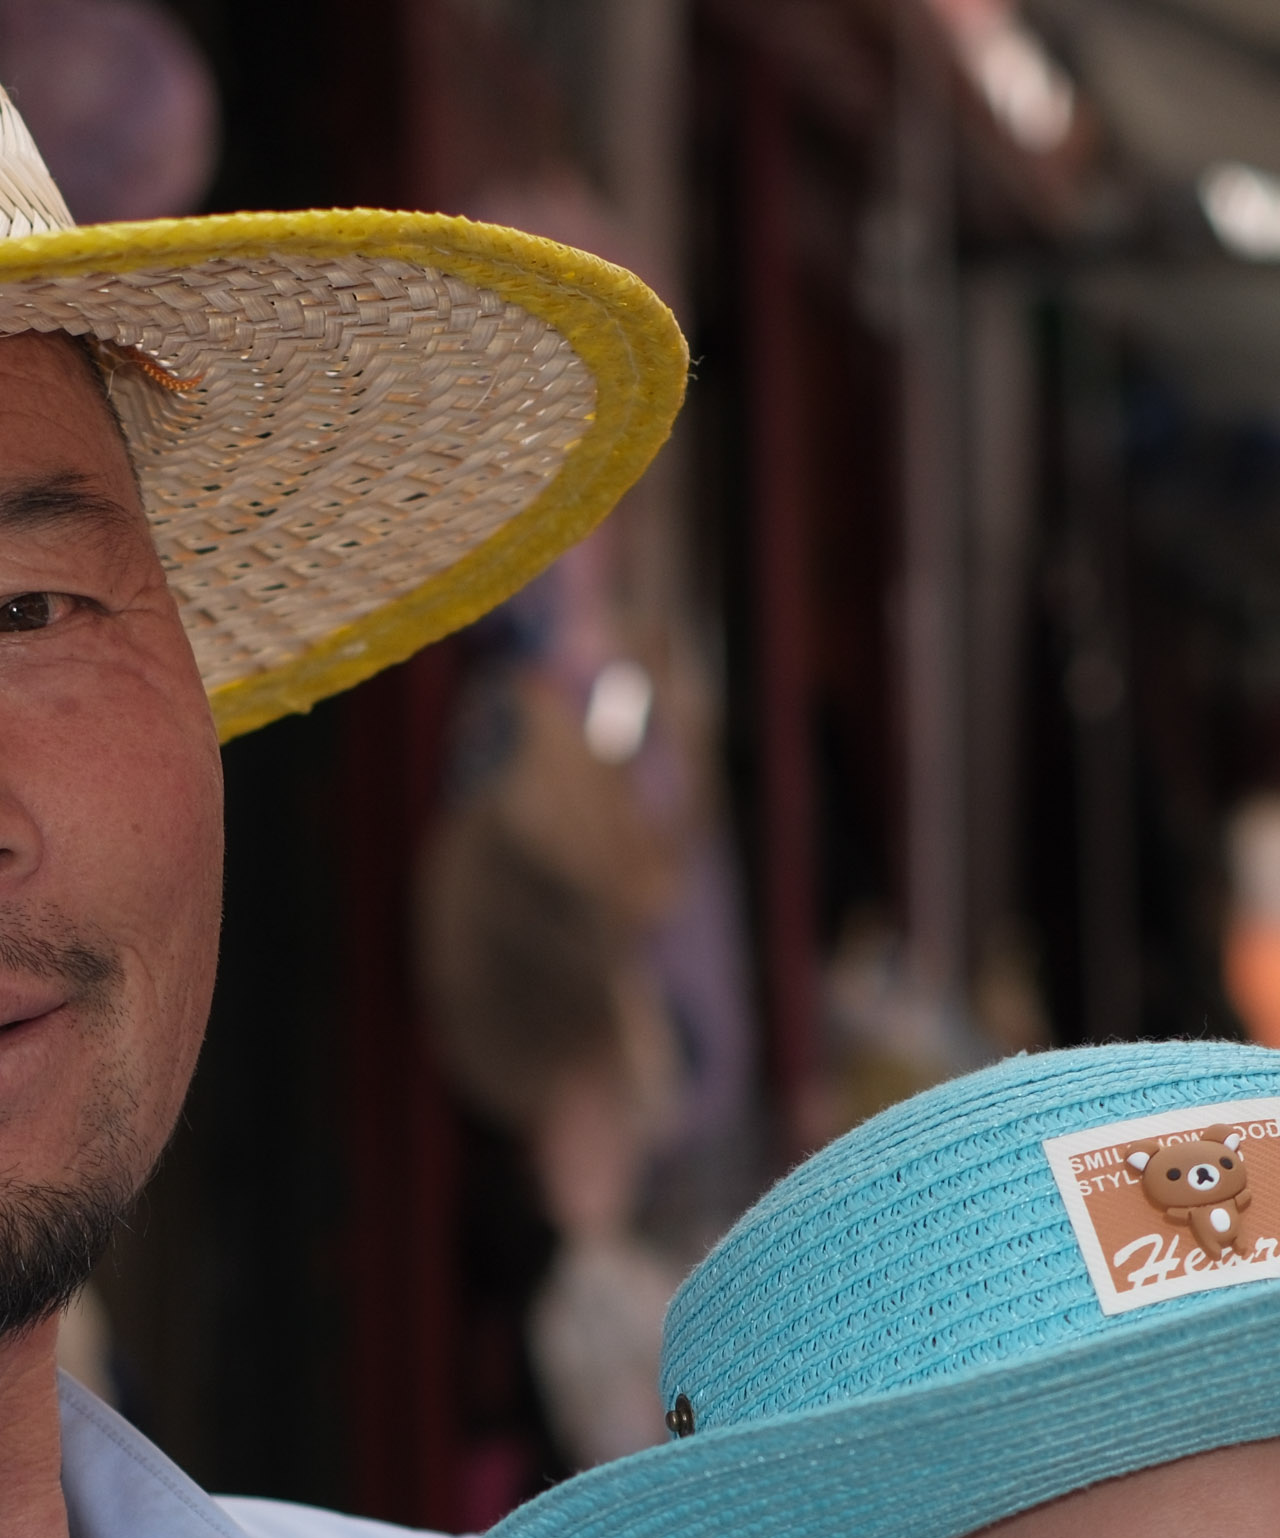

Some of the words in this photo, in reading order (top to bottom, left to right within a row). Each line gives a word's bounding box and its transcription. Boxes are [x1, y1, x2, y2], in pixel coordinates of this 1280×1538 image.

[1070, 1144, 1131, 1175] SMIL
[1232, 1122, 1280, 1142] OOD
[1078, 1169, 1143, 1197] STYL
